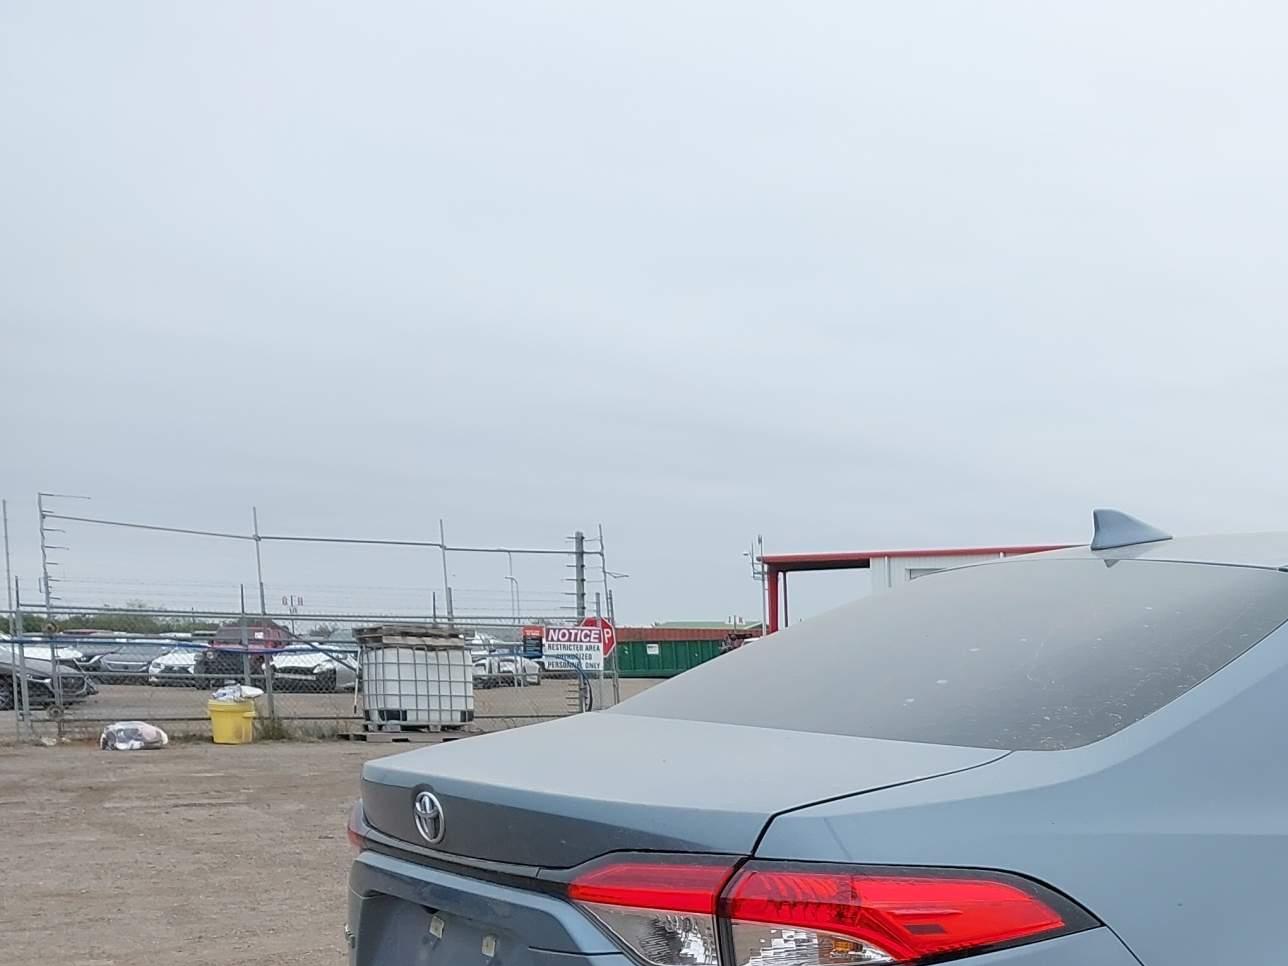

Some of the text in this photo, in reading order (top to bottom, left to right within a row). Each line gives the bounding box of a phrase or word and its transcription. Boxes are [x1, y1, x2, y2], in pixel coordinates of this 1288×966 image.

[548, 628, 600, 643] NOTICE
[547, 643, 600, 652] RESTRICTED AREA
[585, 661, 600, 669] ONLY
